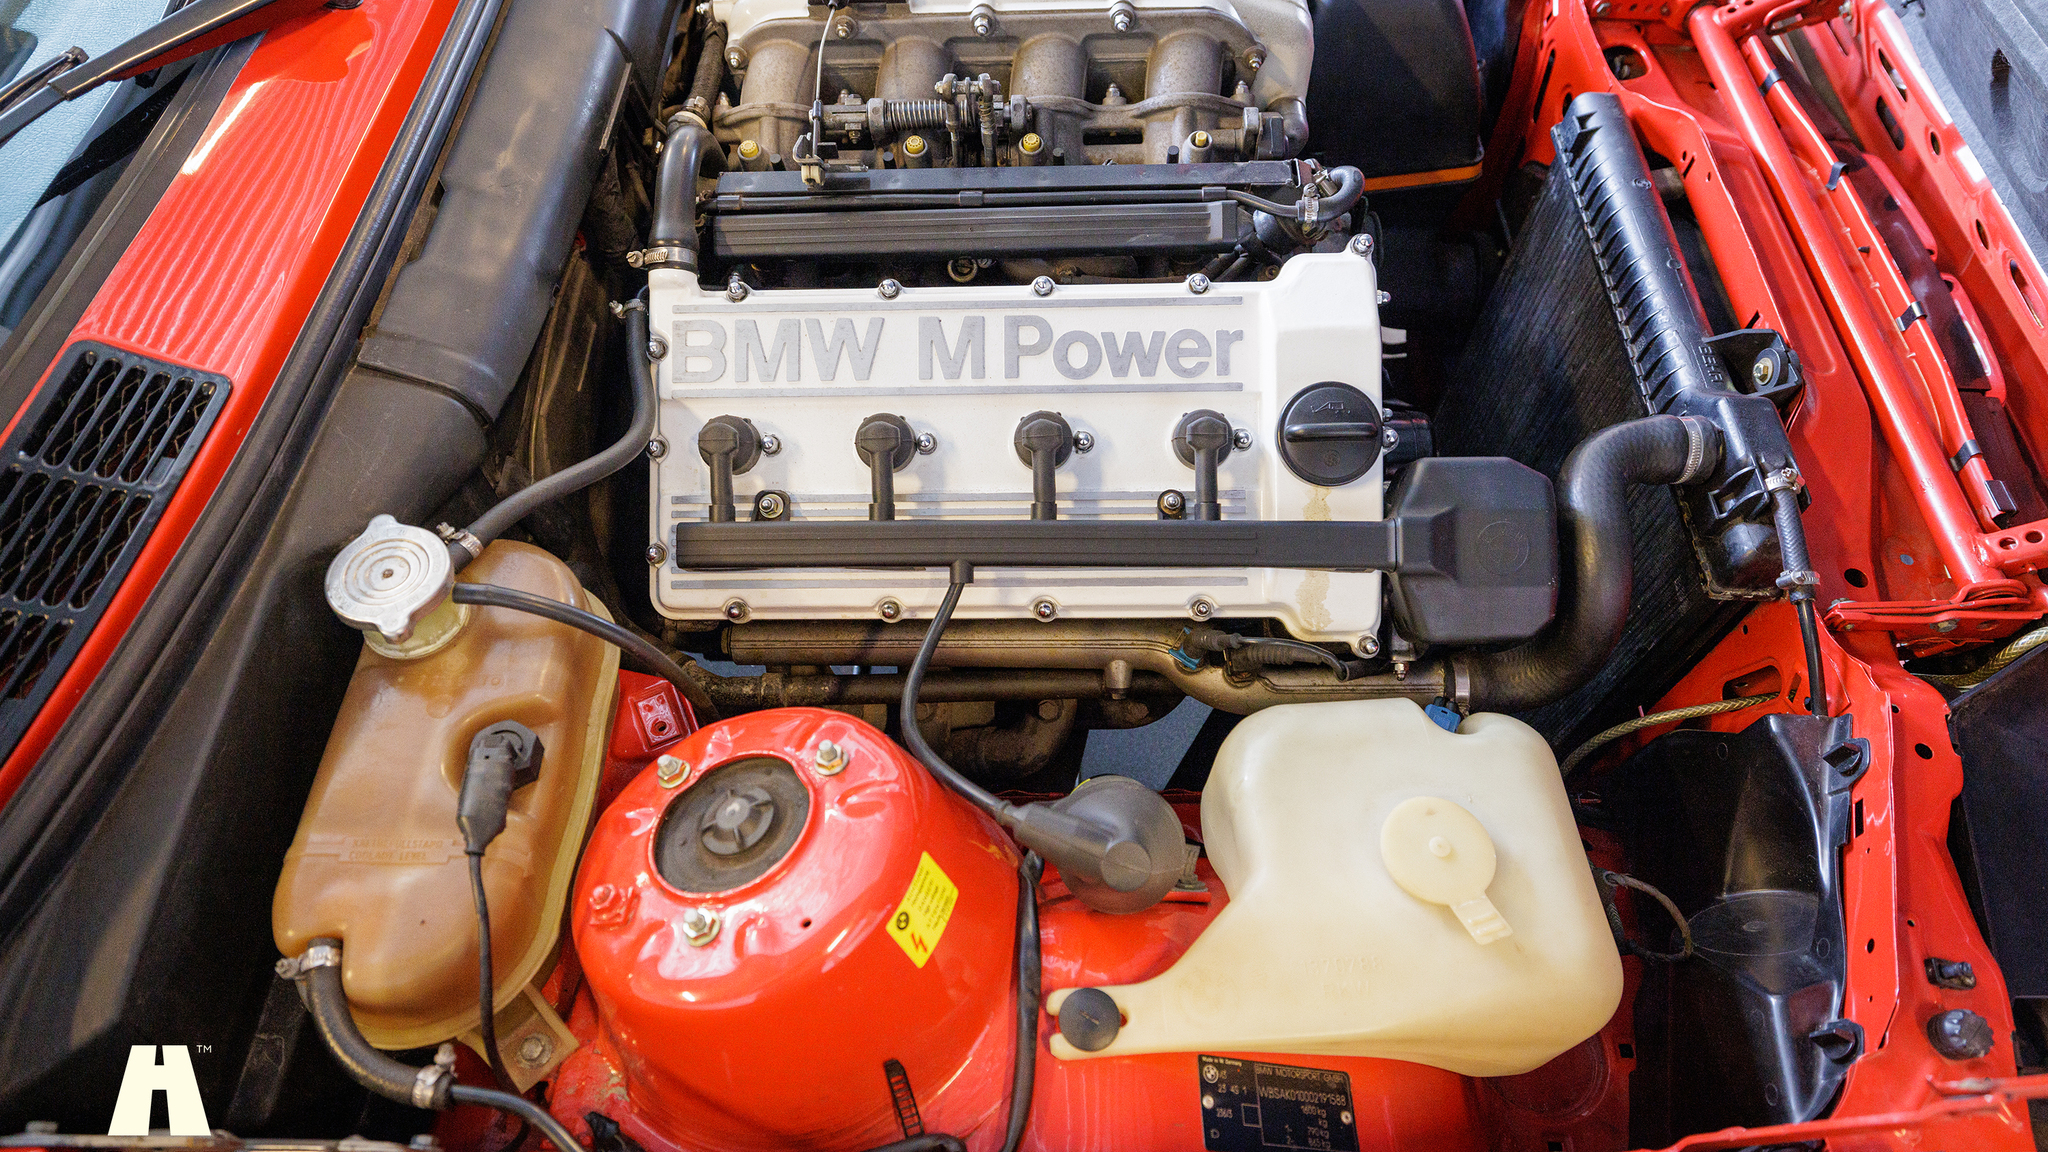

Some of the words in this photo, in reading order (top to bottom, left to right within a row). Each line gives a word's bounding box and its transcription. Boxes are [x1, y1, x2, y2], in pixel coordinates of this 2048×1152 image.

[672, 317, 884, 383] BMW
[918, 315, 985, 380] M
[1003, 315, 1244, 380] Power
[1699, 344, 1723, 383] BEHR
[1275, 1068, 1321, 1081] MOTORSPORT
